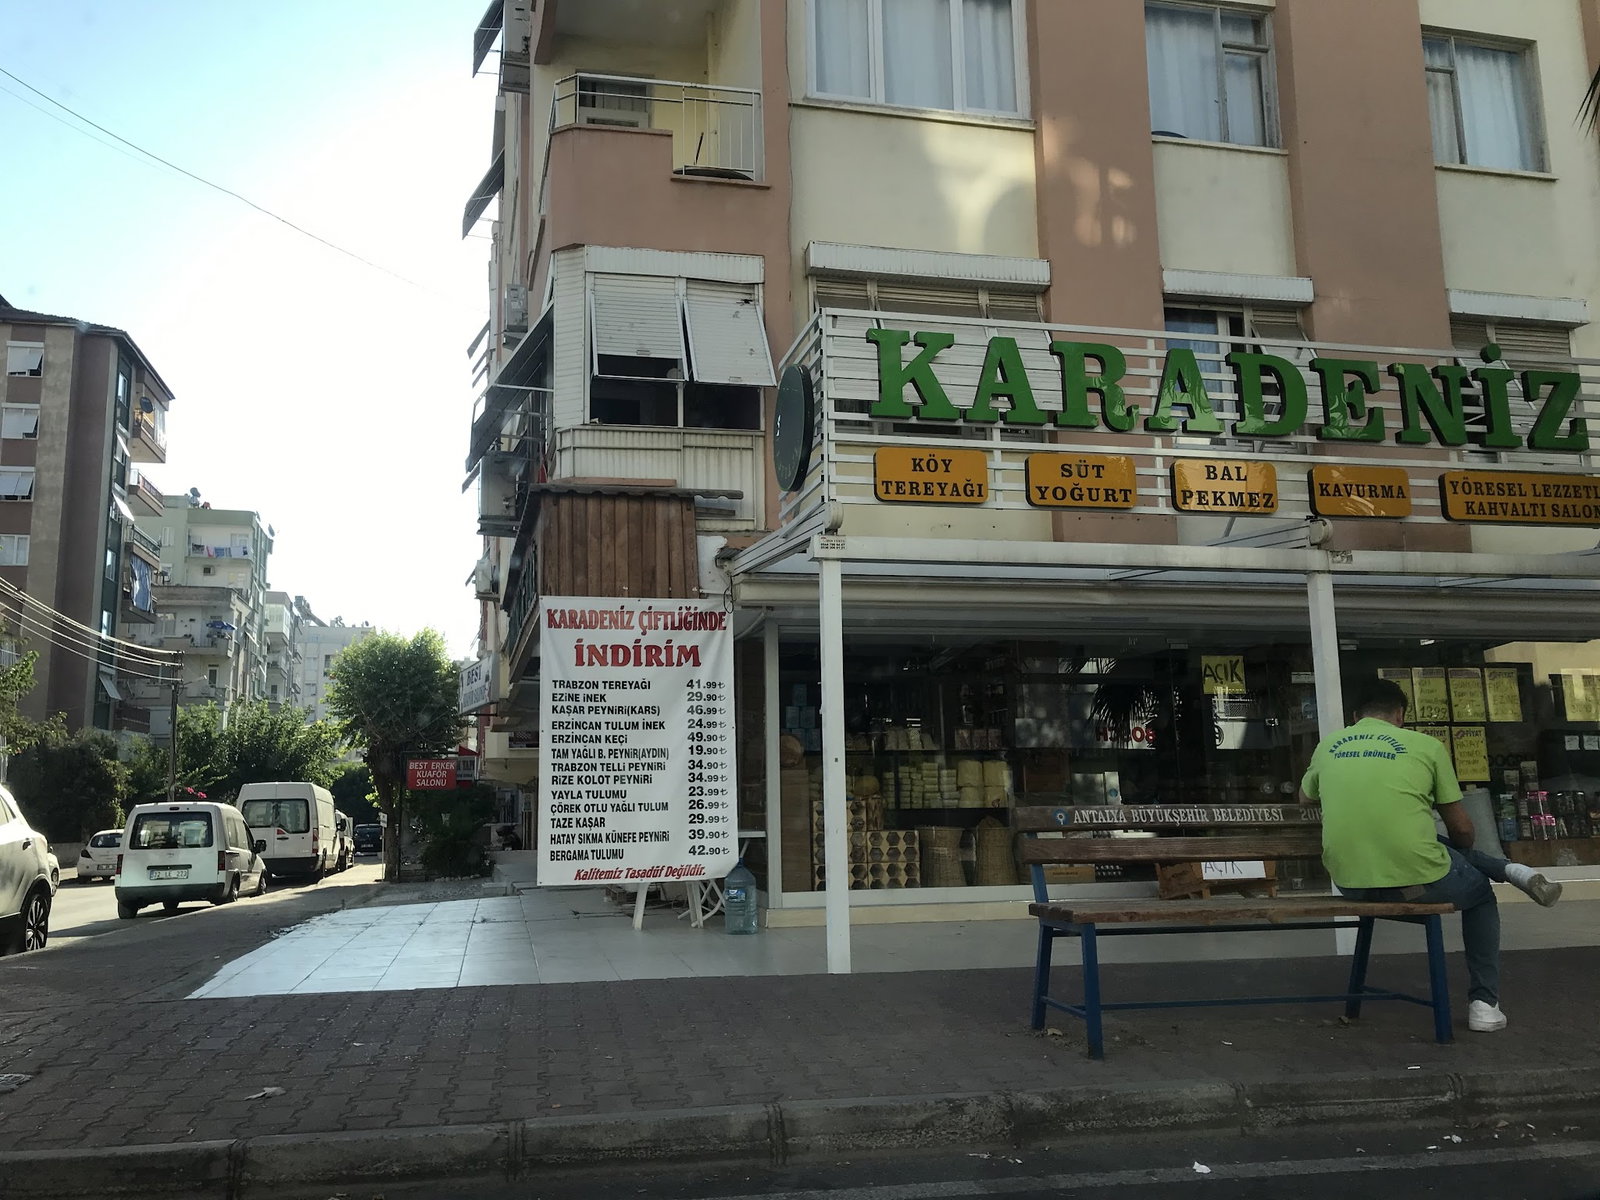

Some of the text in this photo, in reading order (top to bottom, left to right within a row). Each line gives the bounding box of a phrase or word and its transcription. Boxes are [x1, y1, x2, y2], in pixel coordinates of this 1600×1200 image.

[866, 328, 1589, 449] KARADENİZ
[911, 454, 952, 473] KÖY
[1060, 460, 1105, 479] SÜT
[1205, 464, 1247, 481] BAL
[881, 479, 984, 498] TEREYAĞI
[1035, 482, 1132, 503] YOĞURT
[1319, 482, 1406, 499] KAVURMA
[1450, 476, 1527, 498] YÖRESEL
[1181, 490, 1275, 509] PEKMEZ
[1465, 502, 1546, 517] KAHVALTI
[547, 605, 727, 635] KARADENİZ ÇİFTLİĞİNDE
[574, 638, 702, 667] İNDİRİM
[467, 664, 482, 687] BEST
[1203, 658, 1243, 684] AÇIK
[552, 680, 599, 690] TRABZON
[602, 678, 651, 690] TEREYAĞI
[552, 705, 585, 717] KAŞAR
[552, 718, 601, 730] ERZİNCAN
[605, 721, 639, 730] TULUM
[642, 719, 666, 730] İNEK
[552, 732, 601, 743] ERZİNCAN
[552, 748, 570, 759] TAM
[572, 746, 596, 759] YAĞLI
[598, 749, 606, 759] B.
[1363, 749, 1397, 760] ÜRÜNLER
[409, 762, 428, 770] BEST
[431, 761, 455, 770] ERKEK
[551, 762, 597, 772] TRABZON
[416, 779, 447, 787] SALONU
[577, 775, 610, 785] KOLOT
[551, 790, 583, 800] YAYLA
[585, 790, 627, 799] TULUMU
[551, 802, 581, 816] ÇÖREK
[584, 803, 607, 813] OTLU
[610, 801, 635, 813] YAĞLI
[638, 802, 669, 811] TULUM
[1073, 808, 1127, 823] ANTALYA
[1132, 804, 1209, 826] BÜYÜKŞEHİR
[551, 817, 573, 829] TAZE
[575, 817, 606, 831] KAŞAR
[550, 833, 576, 845] HATAY
[578, 833, 603, 844] SIKMA
[605, 830, 637, 844] KÜNEFE
[550, 850, 589, 861] BERGAMA
[591, 849, 624, 860] TULUMU
[574, 867, 623, 881] Kalitemiz
